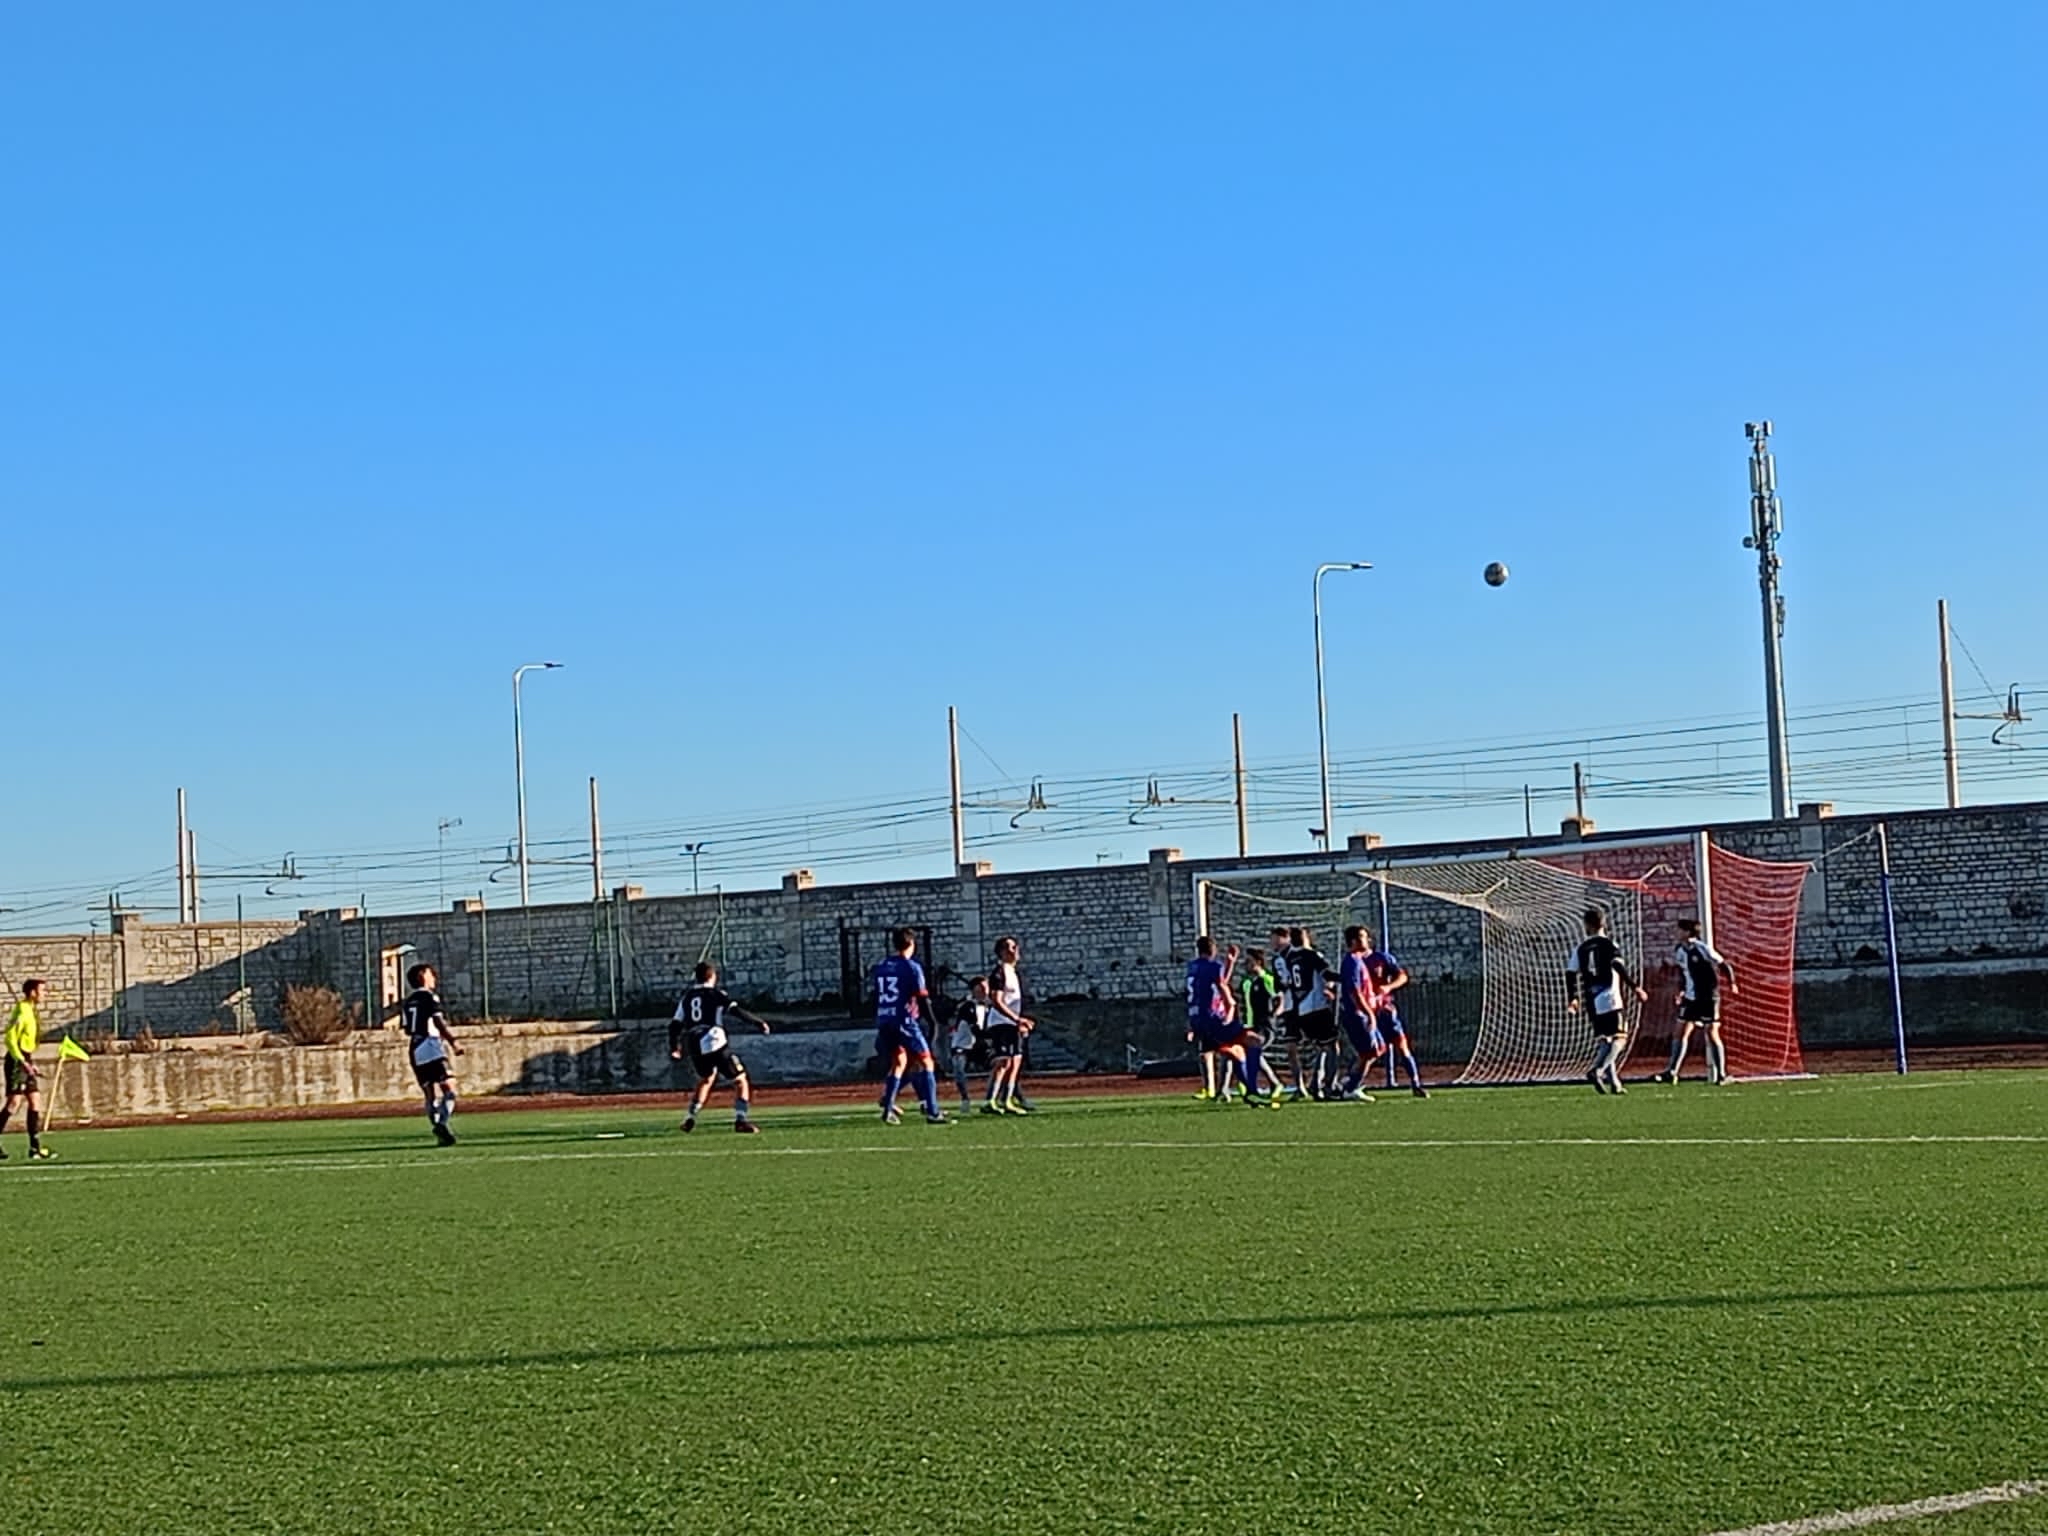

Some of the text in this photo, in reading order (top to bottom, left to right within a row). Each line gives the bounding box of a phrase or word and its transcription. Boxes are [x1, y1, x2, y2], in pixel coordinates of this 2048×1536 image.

[1292, 964, 1302, 988] 6
[408, 1006, 417, 1033] 7
[690, 996, 702, 1022] 8
